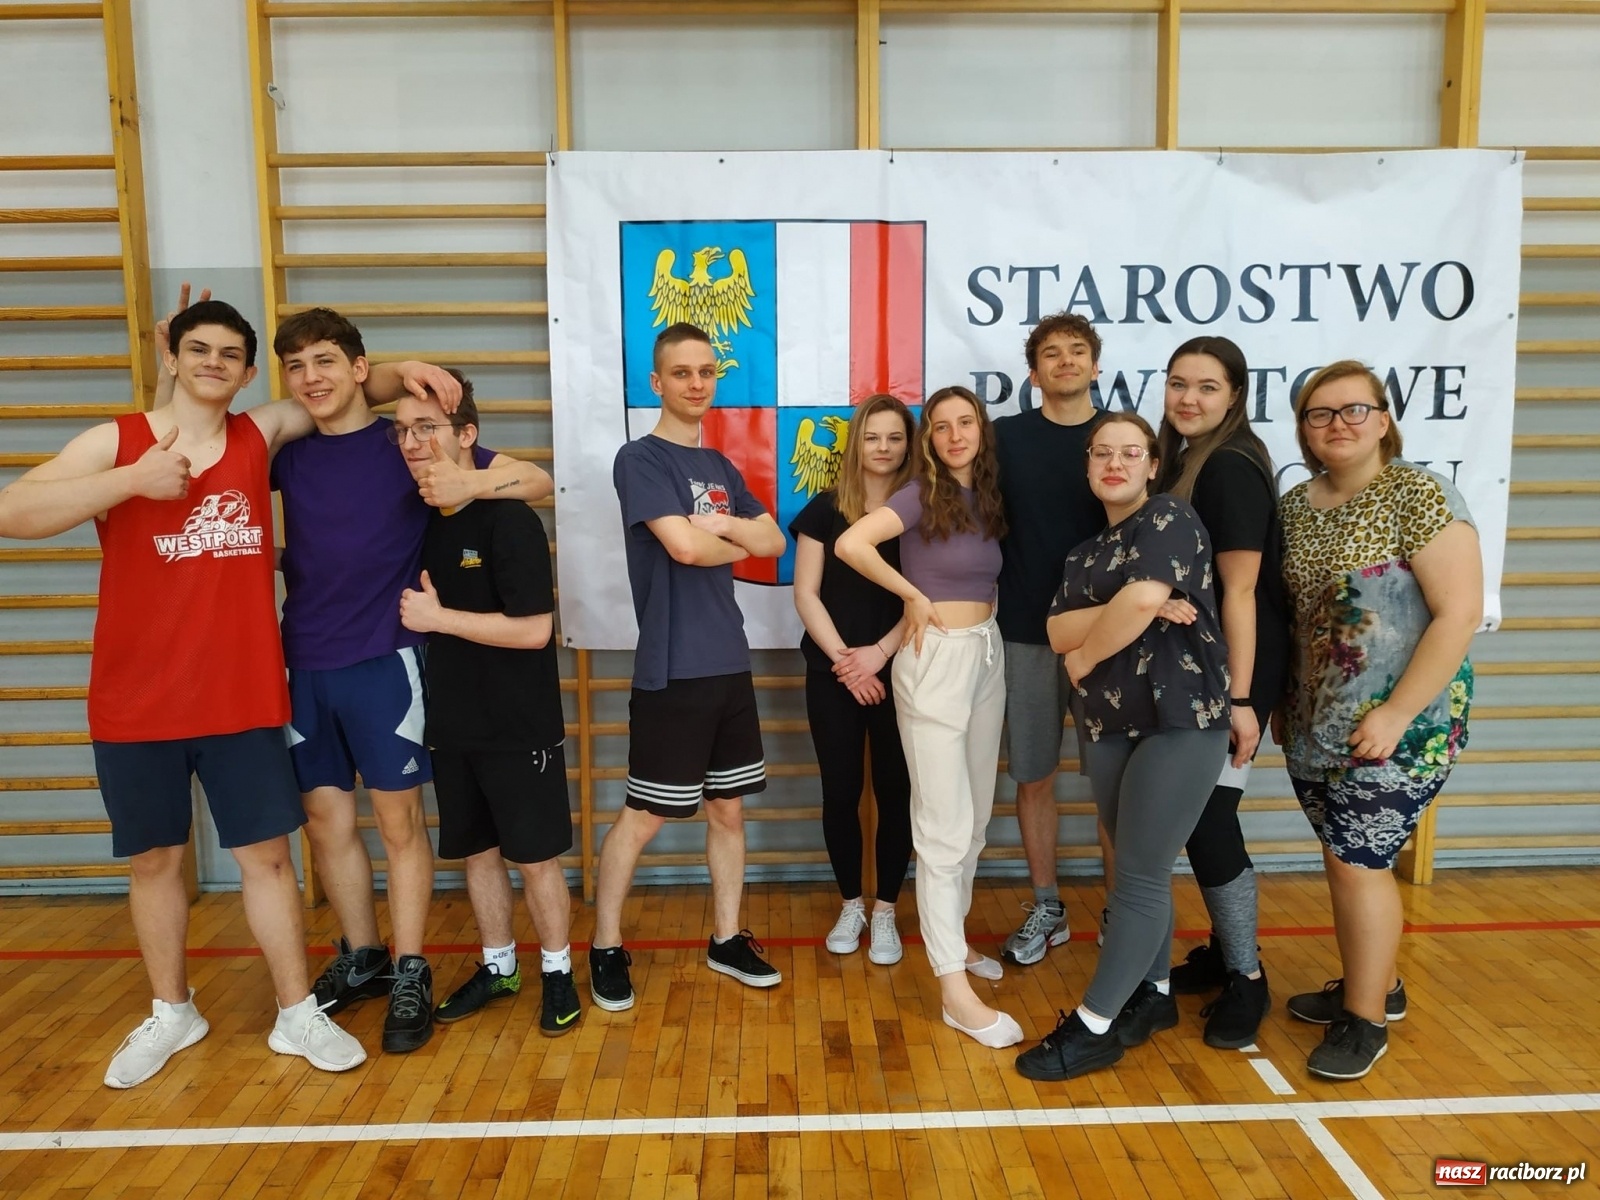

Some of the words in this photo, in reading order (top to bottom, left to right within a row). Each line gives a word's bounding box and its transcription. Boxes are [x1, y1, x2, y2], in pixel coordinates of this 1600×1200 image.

[966, 260, 1475, 327] STAROSTWO
[157, 529, 261, 553] WESTPORT
[213, 547, 262, 558] BASKETBALL
